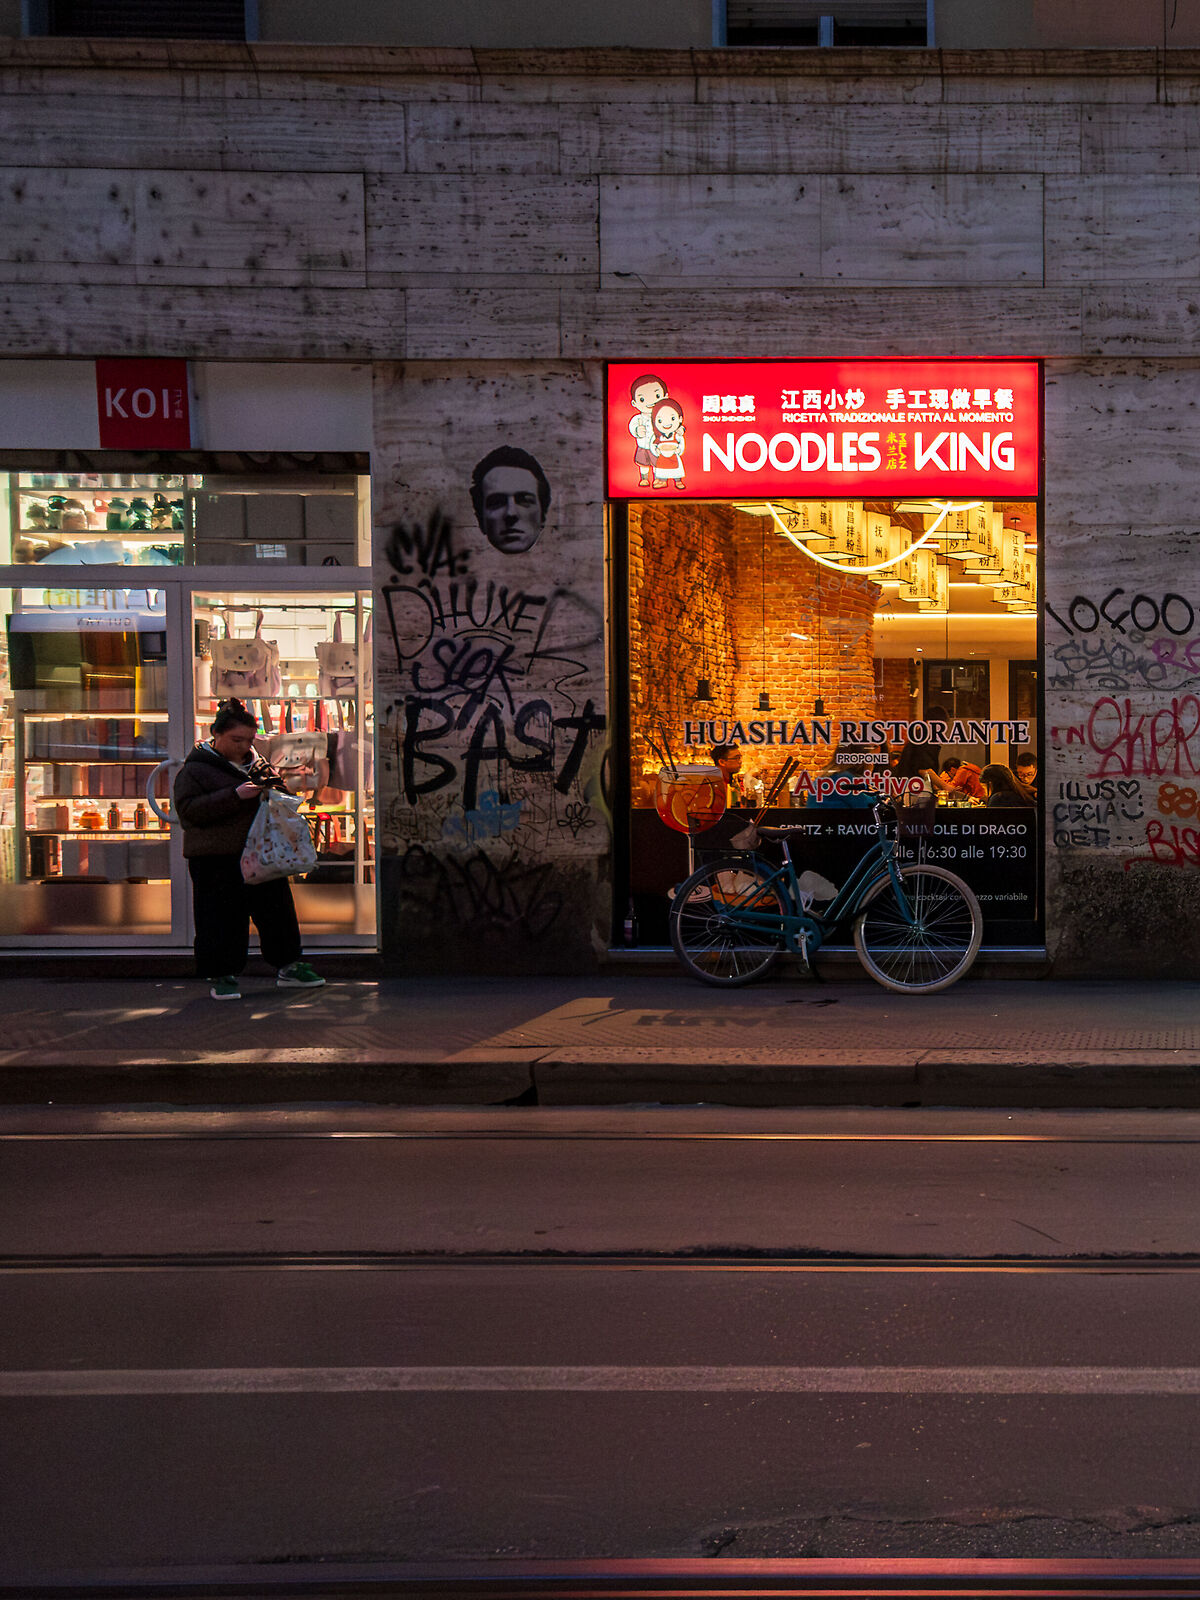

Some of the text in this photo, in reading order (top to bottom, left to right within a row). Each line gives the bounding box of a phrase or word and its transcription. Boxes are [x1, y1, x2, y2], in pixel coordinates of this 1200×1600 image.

[105, 387, 169, 419] KOI
[780, 388, 1014, 411] 江西小炒 手工现做早餐
[782, 412, 1014, 423] RICETTA TRADIZIONALE FATTA AL MOMENTO
[702, 431, 1015, 473] NOODLES KING
[886, 431, 898, 470] 米兰店
[898, 432, 907, 470] MILAN
[683, 720, 1031, 746] HUASHAN RISTORANTE
[836, 753, 889, 765] PROPONE
[793, 769, 925, 803] Aperitivo
[838, 824, 888, 835] RAVIOI
[962, 825, 975, 835] DI
[979, 824, 1027, 836] DRAGO
[921, 845, 957, 858] 16:30
[961, 845, 985, 858] alle
[990, 845, 1027, 858] 19:30
[994, 892, 1028, 900] variabile
